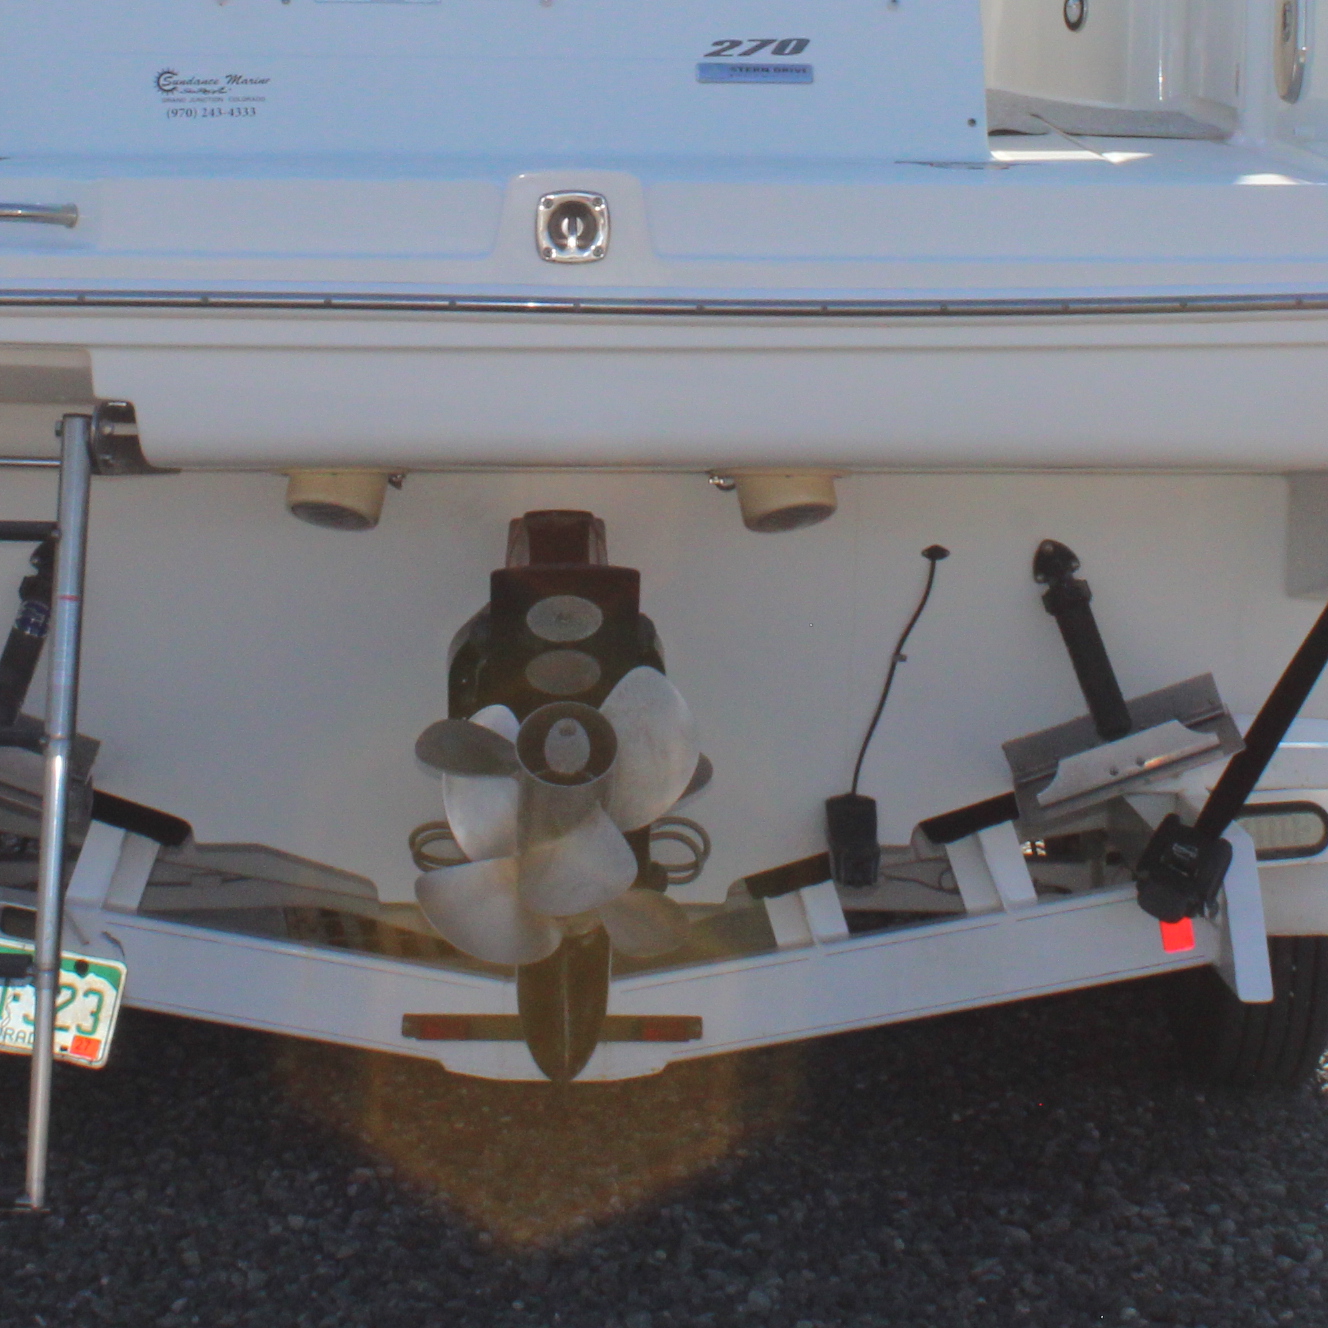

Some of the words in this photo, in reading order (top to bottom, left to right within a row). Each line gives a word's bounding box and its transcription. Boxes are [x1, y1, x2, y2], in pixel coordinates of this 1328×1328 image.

[703, 38, 811, 57] 270
[161, 75, 219, 86] Sundance
[166, 107, 197, 119] (970)
[201, 107, 256, 118] 243-4333
